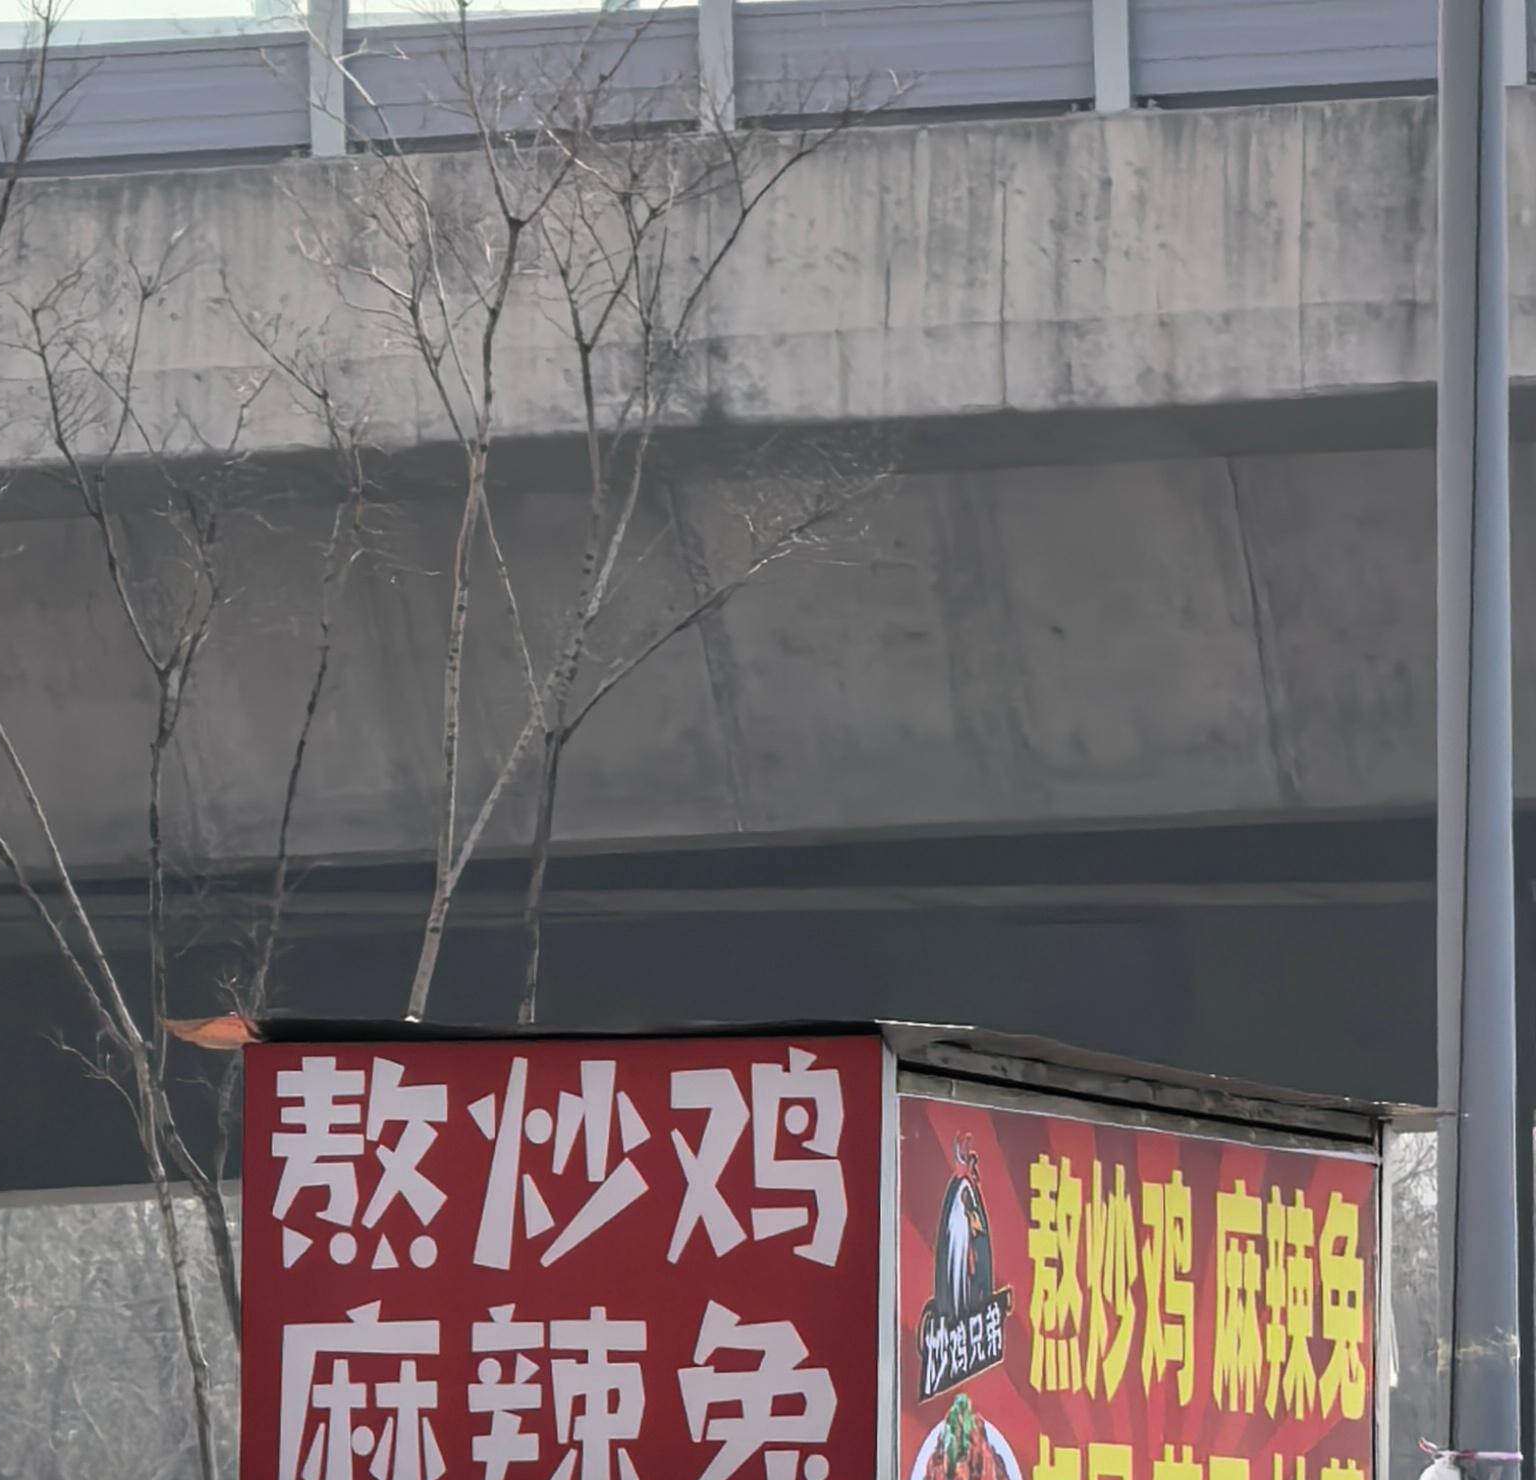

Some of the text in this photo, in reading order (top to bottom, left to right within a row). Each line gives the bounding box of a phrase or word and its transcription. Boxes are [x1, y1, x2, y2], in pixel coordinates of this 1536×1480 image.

[271, 1047, 848, 1270] 熬炒鸡
[925, 1302, 1002, 1394] 炒鸡兄弟
[1027, 1154, 1366, 1420] 熬炒鸡 麻辣兔
